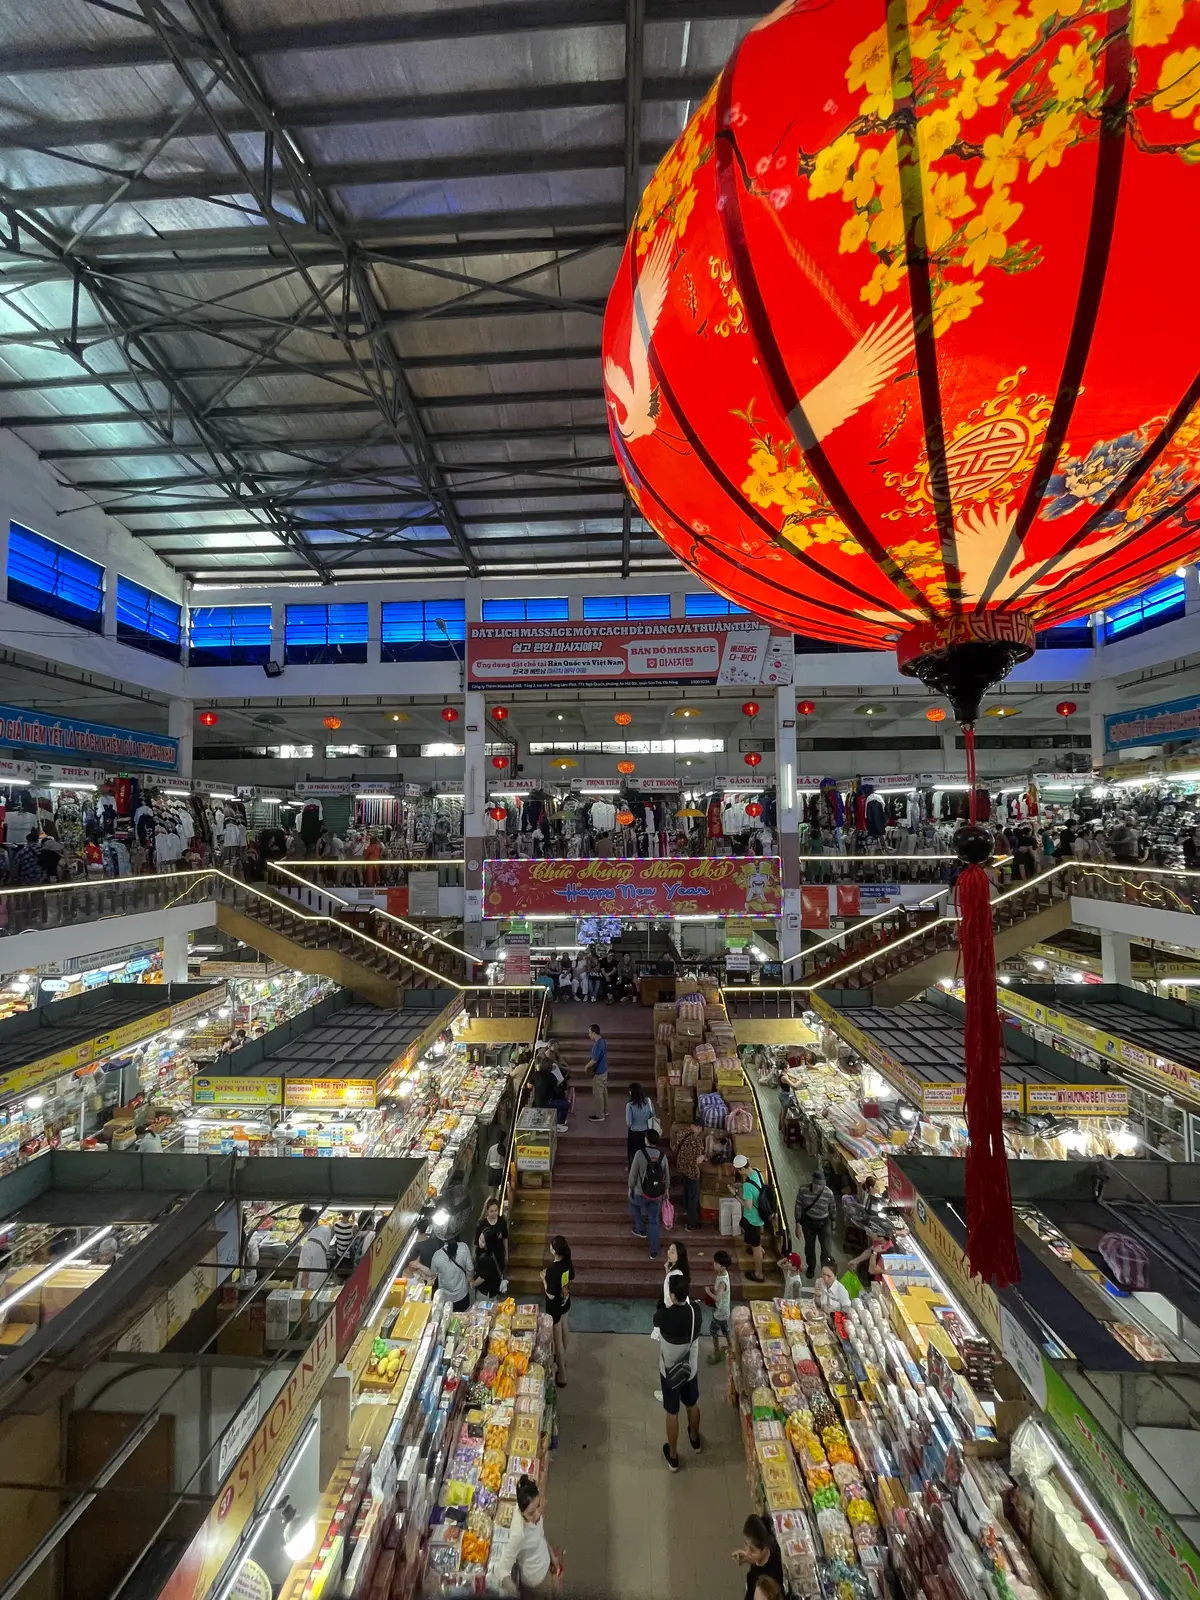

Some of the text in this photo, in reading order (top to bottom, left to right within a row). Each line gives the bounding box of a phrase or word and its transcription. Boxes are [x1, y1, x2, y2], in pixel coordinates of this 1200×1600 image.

[471, 627, 494, 639] ĐẶT
[494, 627, 520, 640] LỊCH
[520, 627, 573, 638] MASSAGE
[573, 625, 599, 639] MỘT
[599, 624, 629, 637] CÁCH
[644, 623, 675, 635] DÀNG
[675, 622, 693, 634] VÀ
[693, 620, 732, 634] THUẬN
[733, 619, 760, 633] TIỆN
[667, 645, 716, 654] MASSAGE
[547, 659, 563, 667] Hàn
[563, 659, 581, 667] Quốc
[591, 658, 606, 667] Việt
[7, 717, 22, 740] GIÁ
[24, 719, 47, 744] NIÊM
[48, 722, 64, 746] YẾT
[75, 728, 100, 751] TRÁCH
[61, 767, 89, 777] THIỆN
[553, 882, 710, 902] Happy New Year
[215, 1084, 233, 1092] SƠN
[1067, 1089, 1090, 1103] HƯƠNG
[238, 1378, 298, 1500] SHOP
[302, 1312, 334, 1389] NHI
